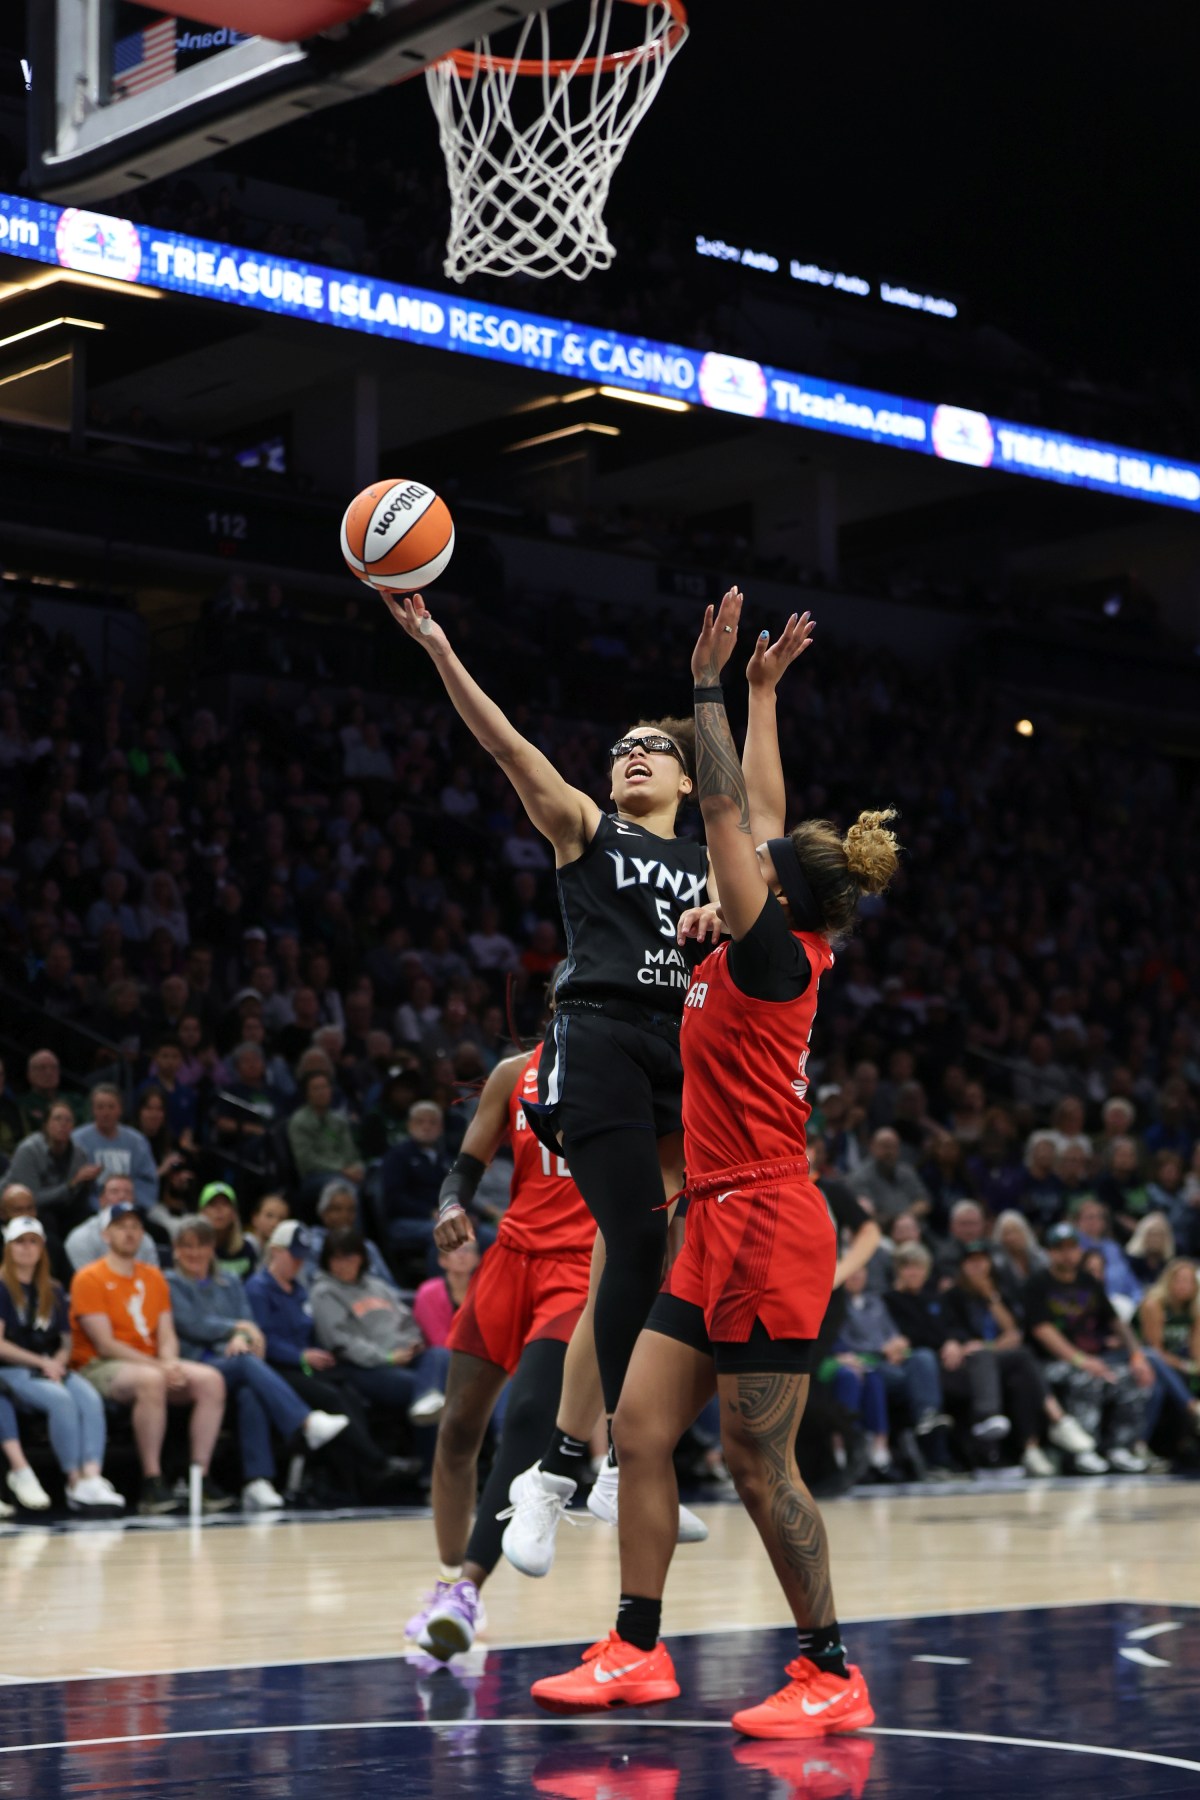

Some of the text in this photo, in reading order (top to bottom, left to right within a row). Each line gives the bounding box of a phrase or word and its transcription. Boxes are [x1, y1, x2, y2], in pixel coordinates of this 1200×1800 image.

[151, 241, 695, 389] TREASURE ISLAND RESORT & CASINO
[997, 429, 1200, 501] TREASURE ISLAND
[206, 511, 248, 539] 112
[373, 484, 429, 536] Wilson
[605, 849, 707, 907] LYNX
[655, 898, 677, 938] 5
